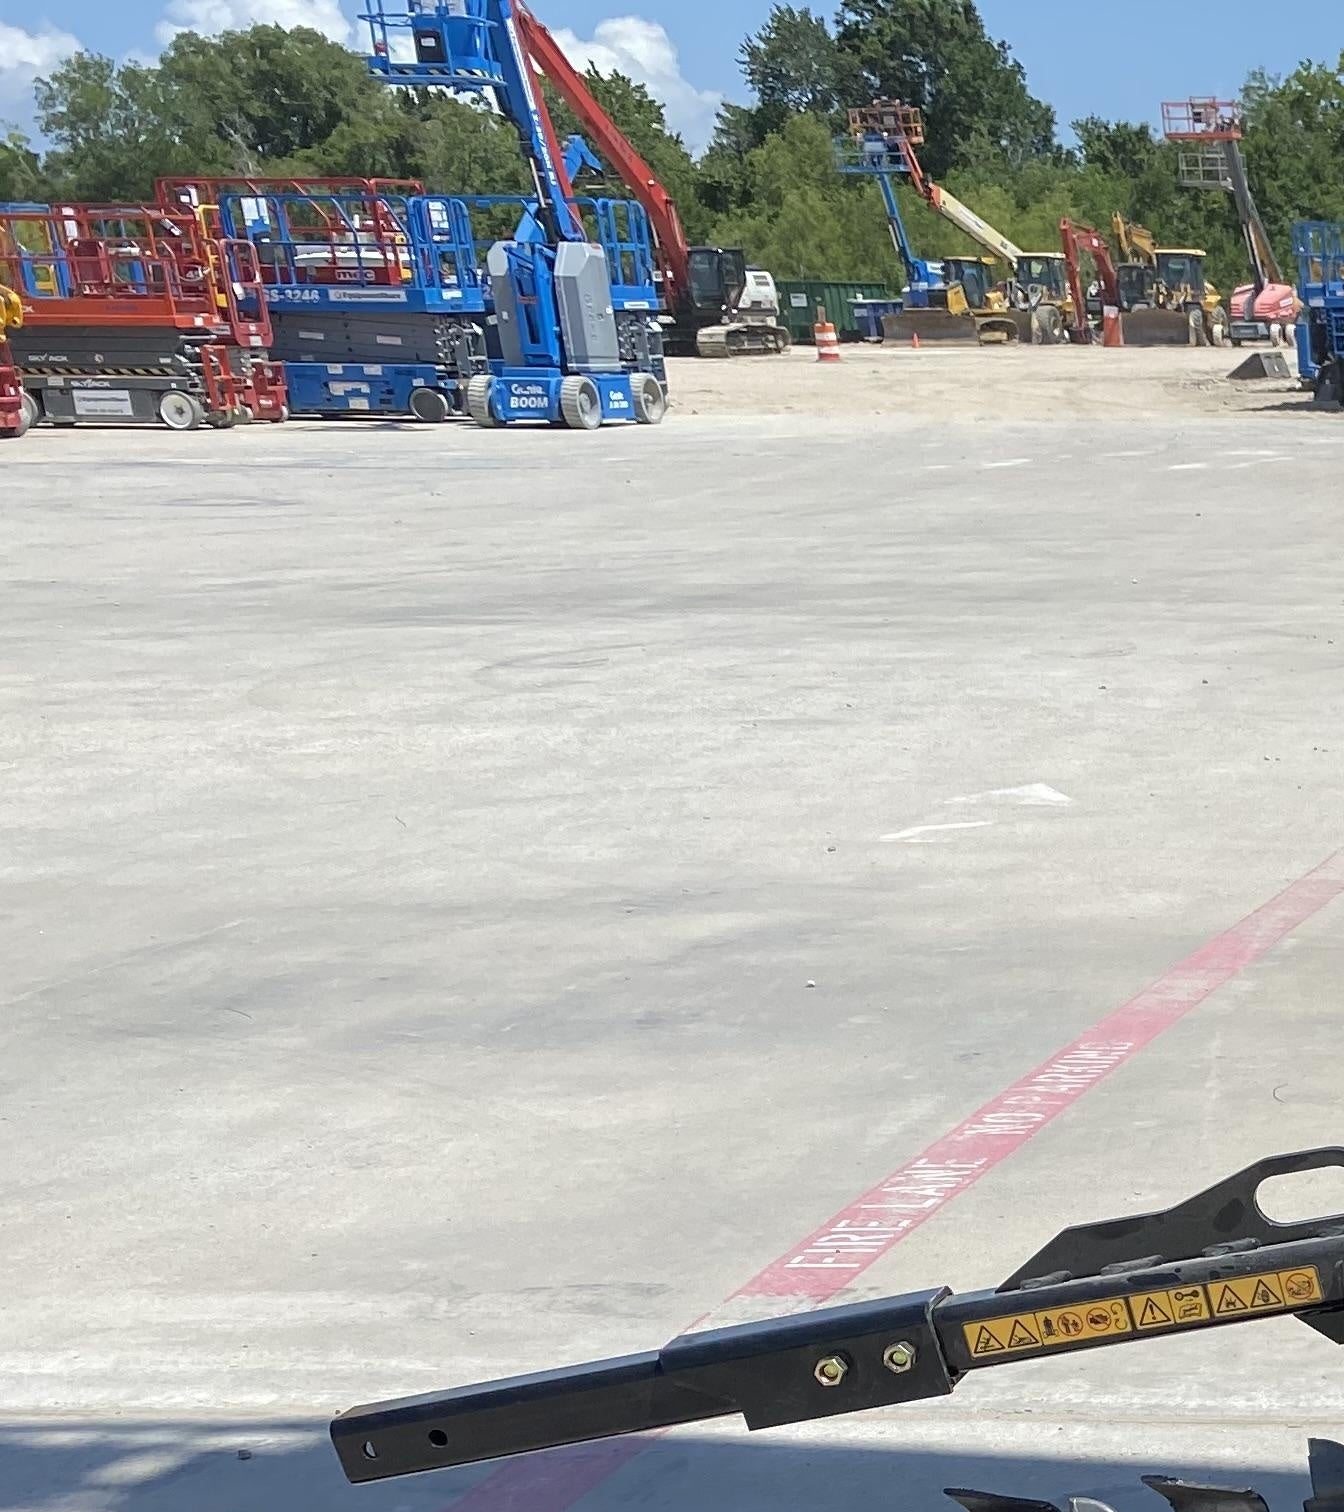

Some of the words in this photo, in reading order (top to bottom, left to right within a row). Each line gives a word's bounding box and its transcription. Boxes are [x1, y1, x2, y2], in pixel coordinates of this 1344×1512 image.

[511, 396, 549, 408] BOOM
[784, 1219, 913, 1269] FIRE
[861, 1157, 988, 1209] LANE
